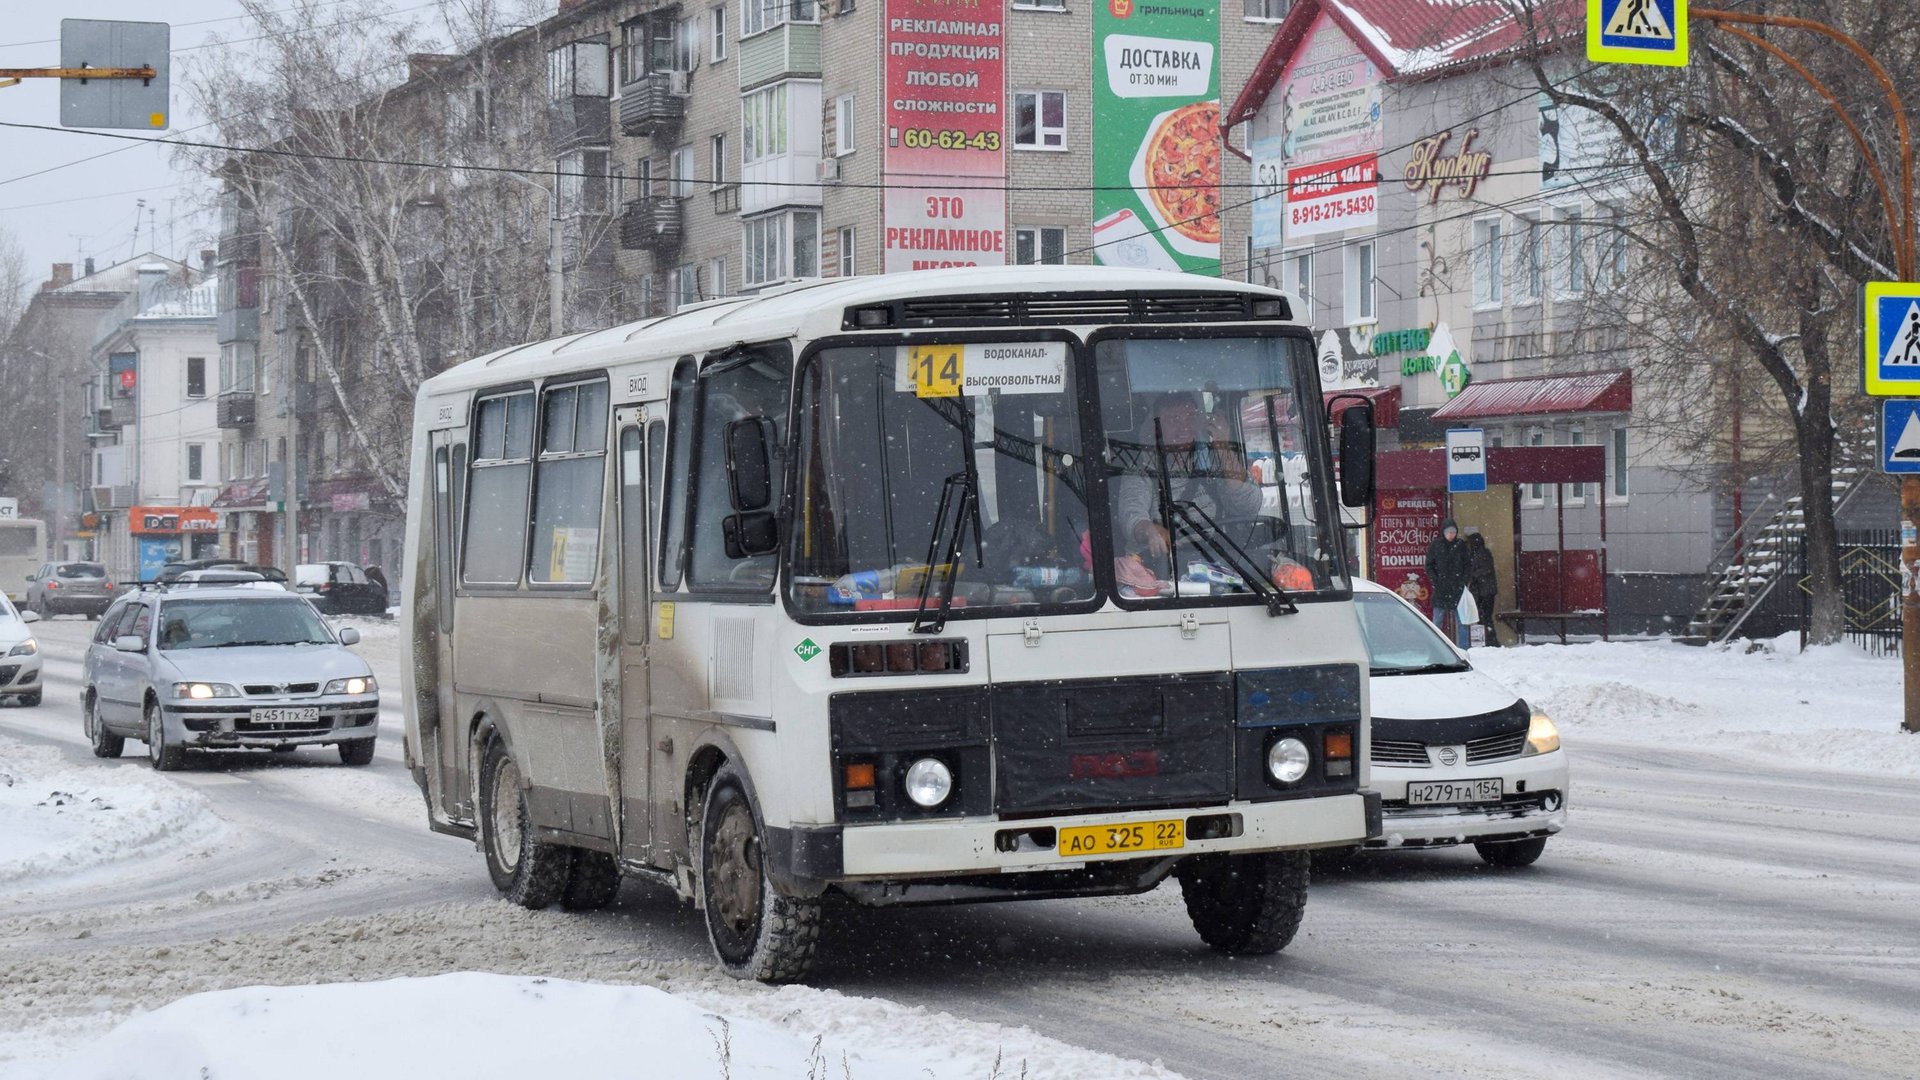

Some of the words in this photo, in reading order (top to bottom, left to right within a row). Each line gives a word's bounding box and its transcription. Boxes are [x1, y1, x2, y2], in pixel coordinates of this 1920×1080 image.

[1139, 5, 1205, 17] грильница
[891, 18, 1000, 36] РЕКЛАМНАЯ
[890, 42, 1000, 61] ПРОДУКЦИЯ
[1120, 48, 1201, 70] ДОСТАВКА
[905, 70, 979, 88] ЛЮБОЙ
[1129, 73, 1142, 84] ОТ
[1144, 74, 1155, 85] 30
[1157, 75, 1178, 86] МИН
[893, 99, 998, 114] СЛОЖНОСТИ
[904, 127, 1001, 151] 60-62-43
[1293, 170, 1338, 195] АРЕНДА
[1341, 165, 1360, 185] 144
[926, 197, 964, 219] ЭТО
[886, 227, 1003, 252] РЕКЛАМНОЕ
[1373, 329, 1427, 356] АПТЕКА
[919, 353, 960, 387] 14
[1402, 355, 1442, 376] ДОКТОР
[629, 377, 647, 393] ВХОД
[966, 375, 1061, 387] ВЫСОКОВОЛЬТНАЯ
[438, 407, 453, 421] ВХОД
[1397, 500, 1437, 509] КРЕНДЕЛЬ
[1380, 517, 1404, 528] ТЕПЕРЬ
[1378, 528, 1439, 545] ВКУСНЫЕ
[1380, 546, 1387, 554] С
[1390, 546, 1429, 554] НАЧИНК
[1381, 555, 1426, 566] ПОНЧИ
[797, 646, 817, 655] СНГ
[303, 708, 315, 718] 22
[1414, 785, 1473, 802] Н279ТА
[1476, 781, 1498, 795] 154
[1071, 835, 1095, 851] АО
[1106, 827, 1143, 849] 325
[1157, 823, 1176, 839] 22
